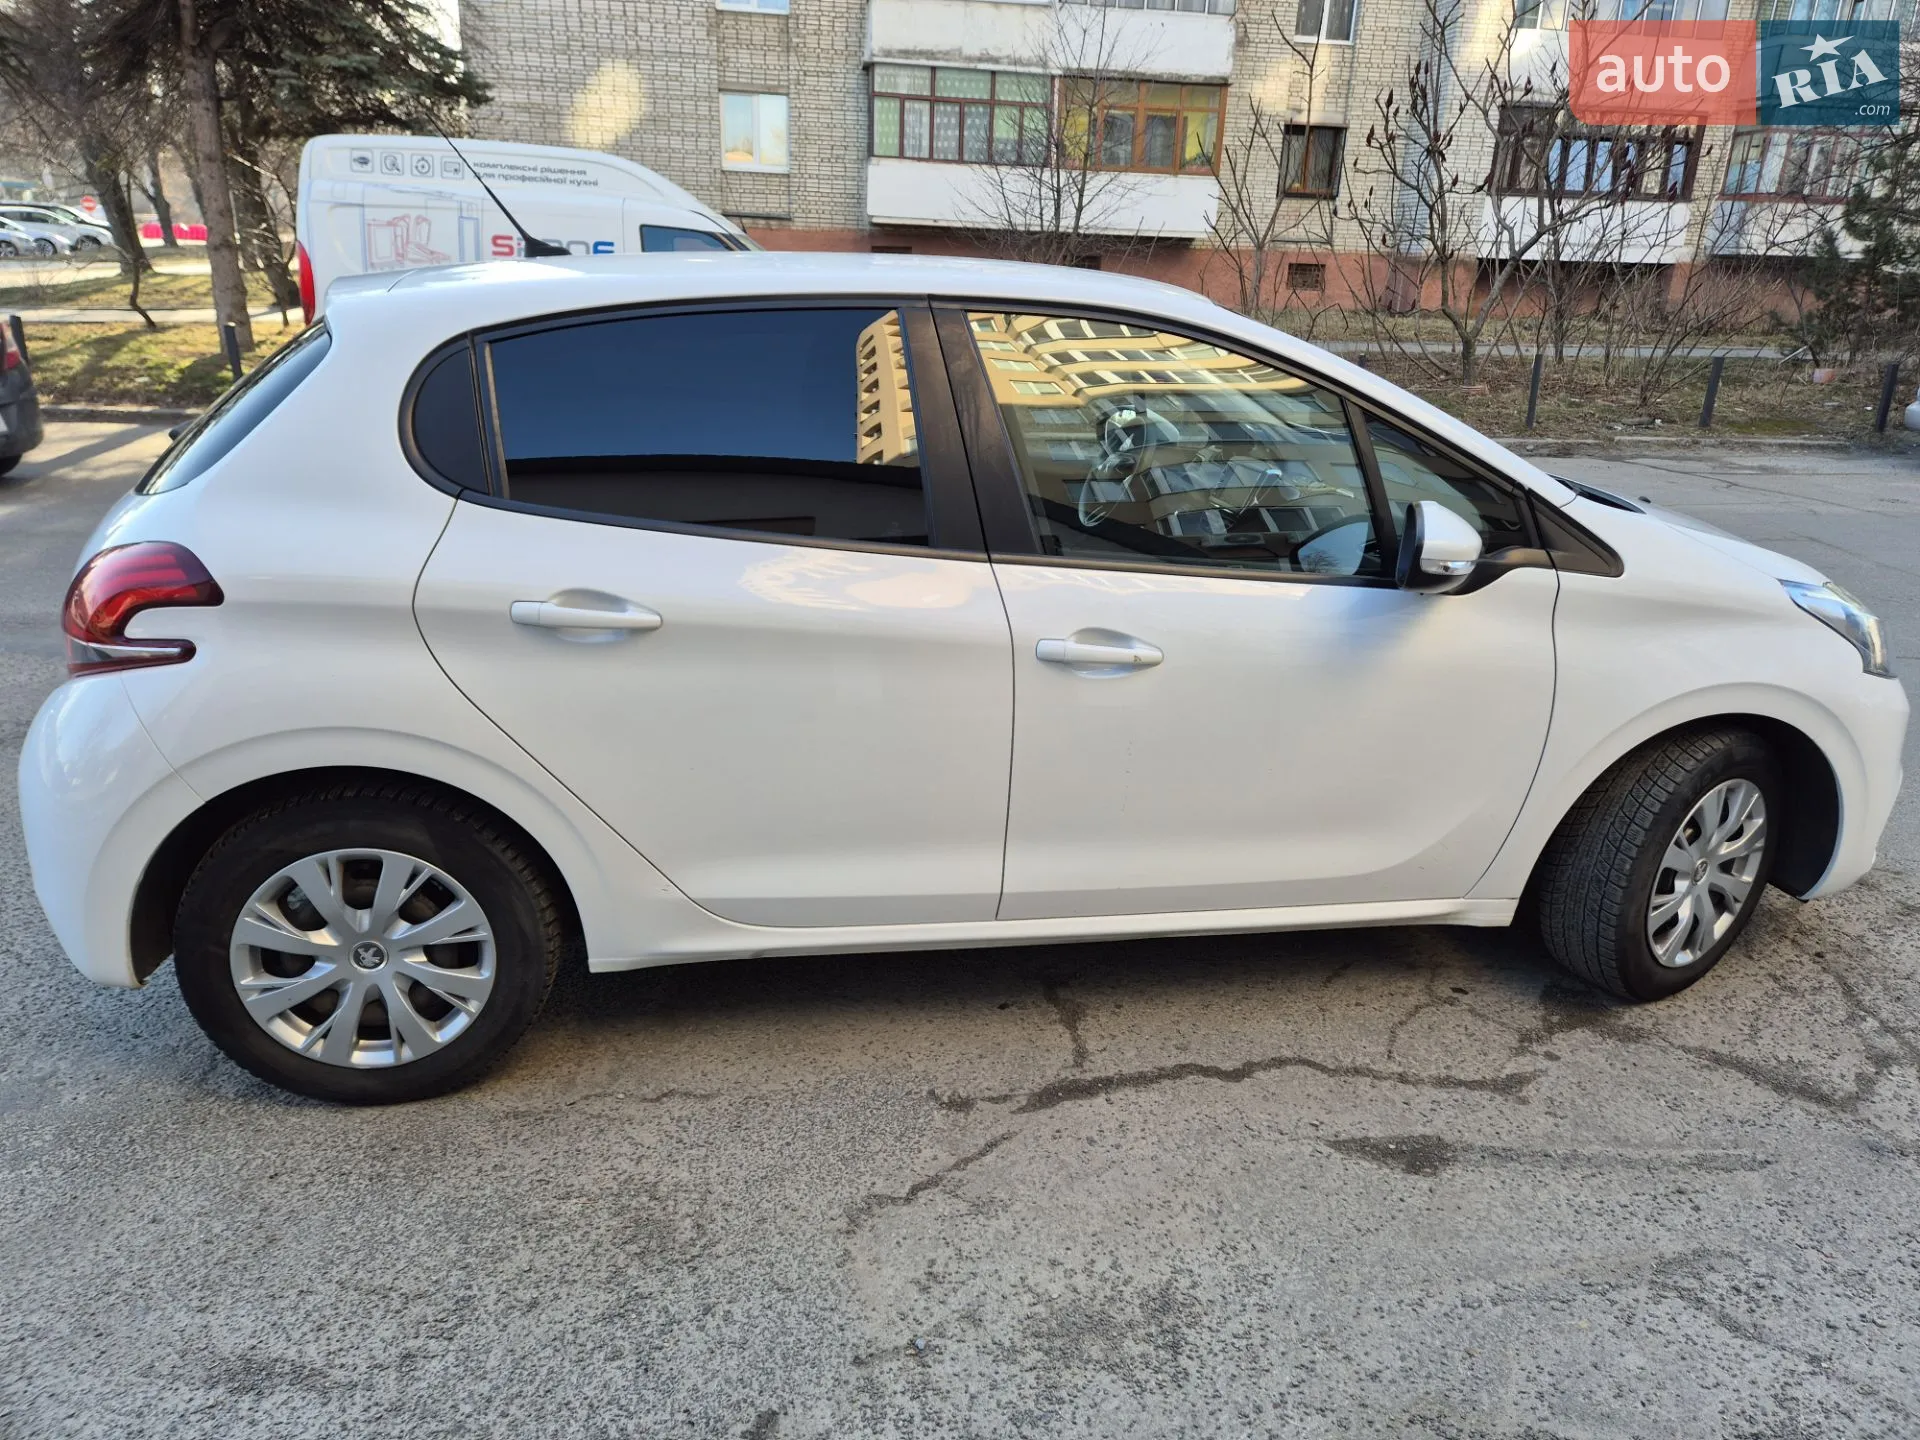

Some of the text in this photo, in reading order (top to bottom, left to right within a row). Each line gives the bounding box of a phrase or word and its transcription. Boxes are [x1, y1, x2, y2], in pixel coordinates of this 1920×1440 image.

[473, 162, 587, 175] комплексні рішення
[498, 172, 567, 184] професійної
[569, 179, 599, 187] кухні
